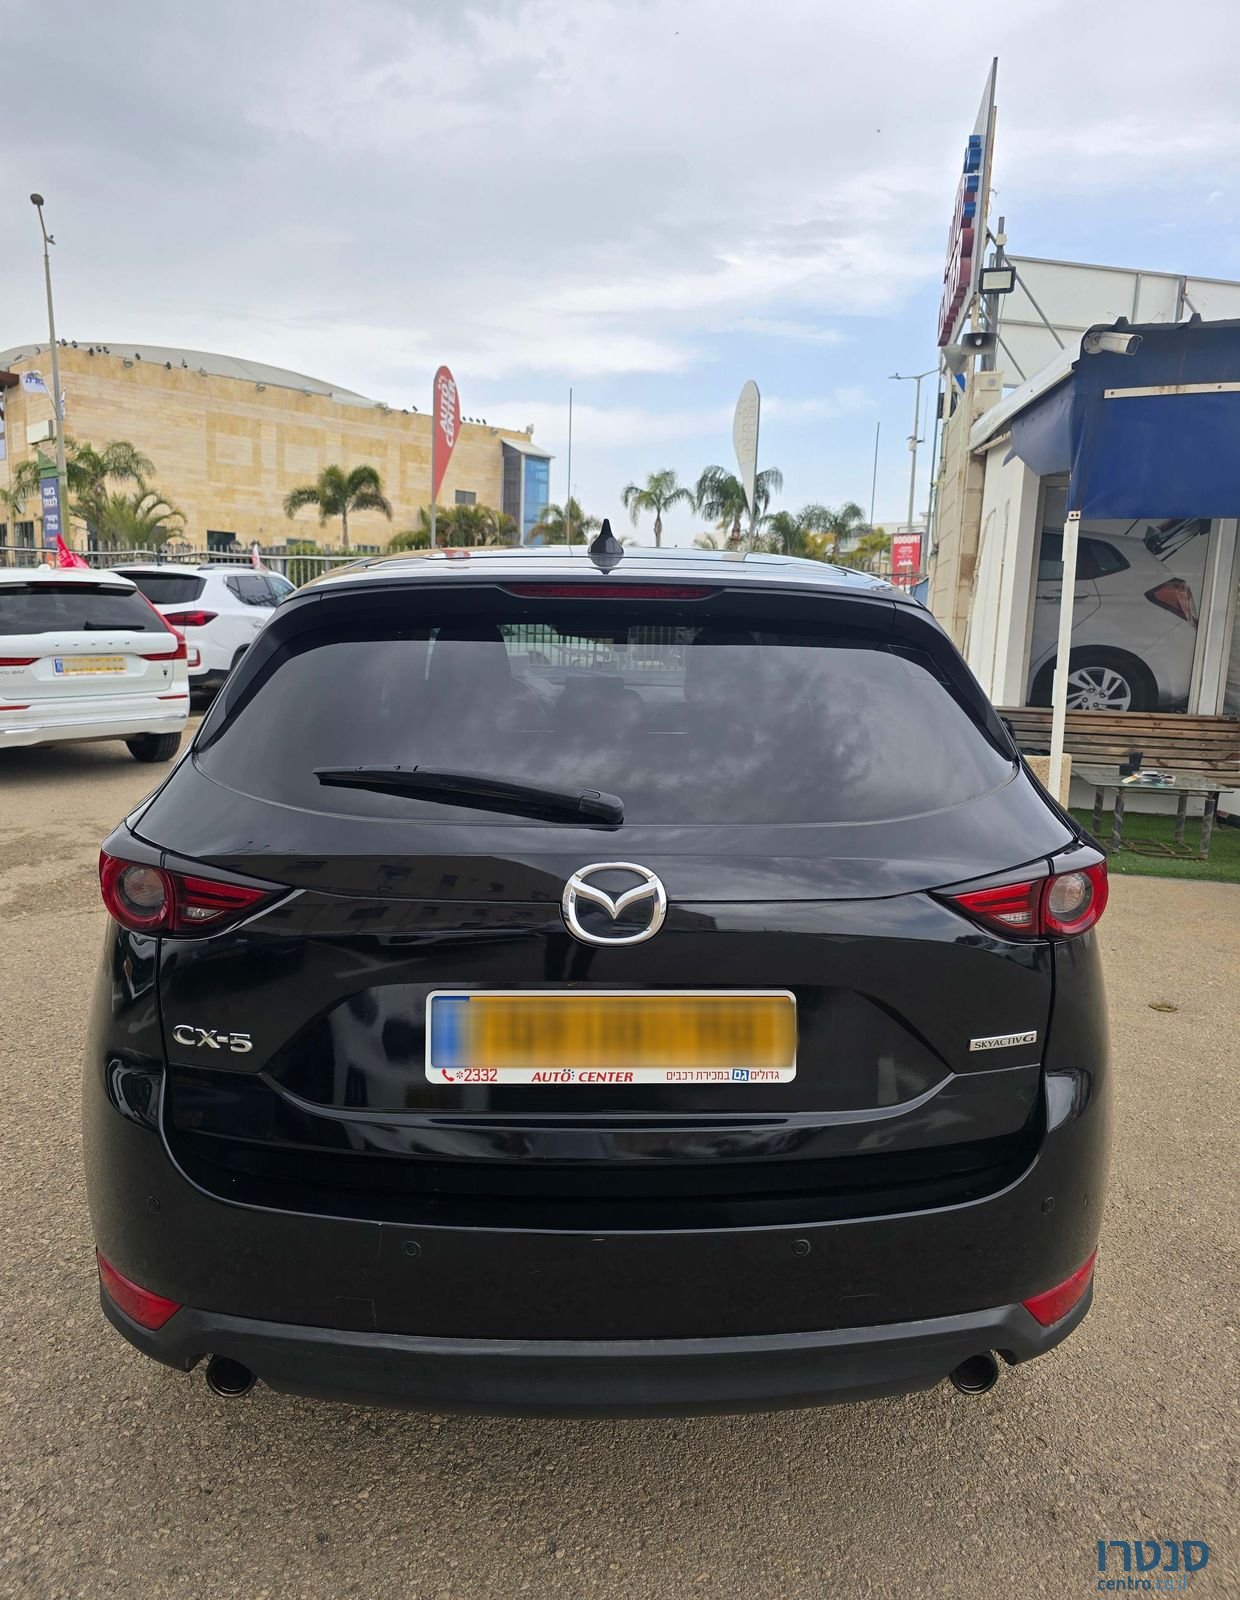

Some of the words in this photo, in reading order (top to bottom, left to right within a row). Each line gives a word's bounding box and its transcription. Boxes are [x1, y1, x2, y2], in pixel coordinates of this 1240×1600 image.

[440, 382, 449, 433] AUTO
[446, 379, 456, 448] CENTER
[172, 1024, 253, 1053] CX-5
[531, 1071, 572, 1083] AUTO
[578, 1071, 634, 1083] CENTER
[666, 1071, 693, 1081] רכבים
[696, 1071, 730, 1081] במכירת
[733, 1069, 748, 1081] גם
[750, 1069, 780, 1080] גדולים
